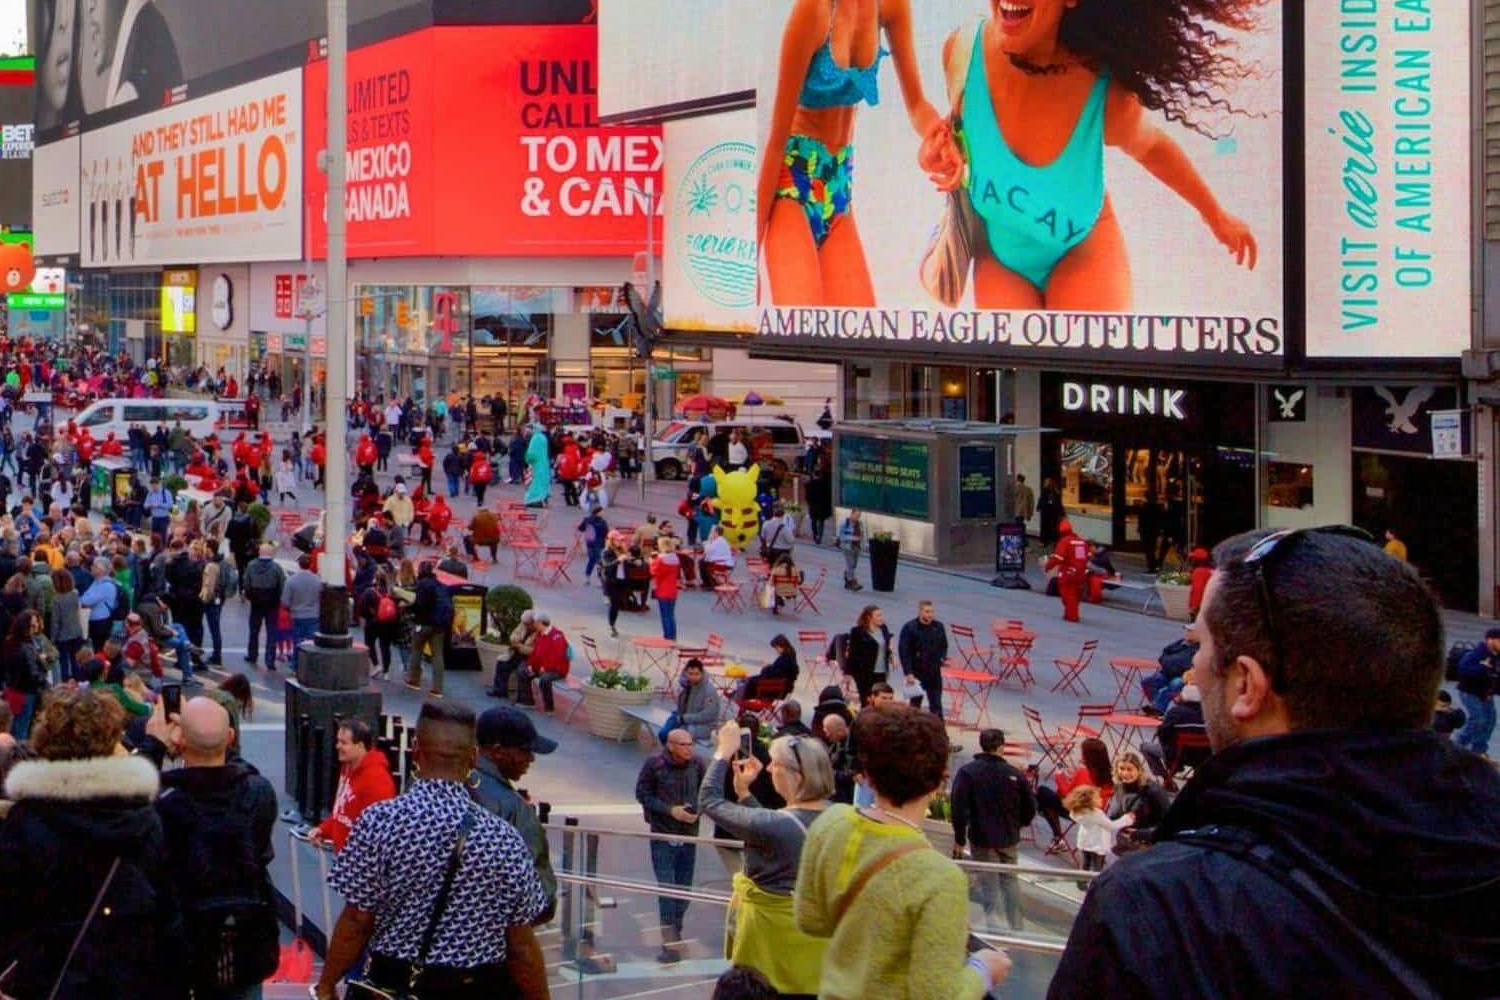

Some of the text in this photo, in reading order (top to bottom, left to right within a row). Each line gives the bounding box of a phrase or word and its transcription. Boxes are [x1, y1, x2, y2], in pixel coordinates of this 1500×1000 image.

[2, 124, 35, 142] BET
[131, 93, 286, 160] AND THEY STILL HAD ME
[371, 108, 411, 139] TEXTS
[1394, 48, 1432, 234] AMERICAN
[346, 141, 412, 183] MEXICO
[519, 135, 579, 173] TO
[1326, 110, 1378, 230] aerie
[133, 160, 165, 223] AT
[520, 177, 551, 217] &
[1341, 237, 1378, 331] VISIT
[1395, 248, 1432, 289] OF
[758, 308, 1281, 355] AMERICAN EAGLE OUTFITTERS
[1061, 382, 1185, 419] DRINK
